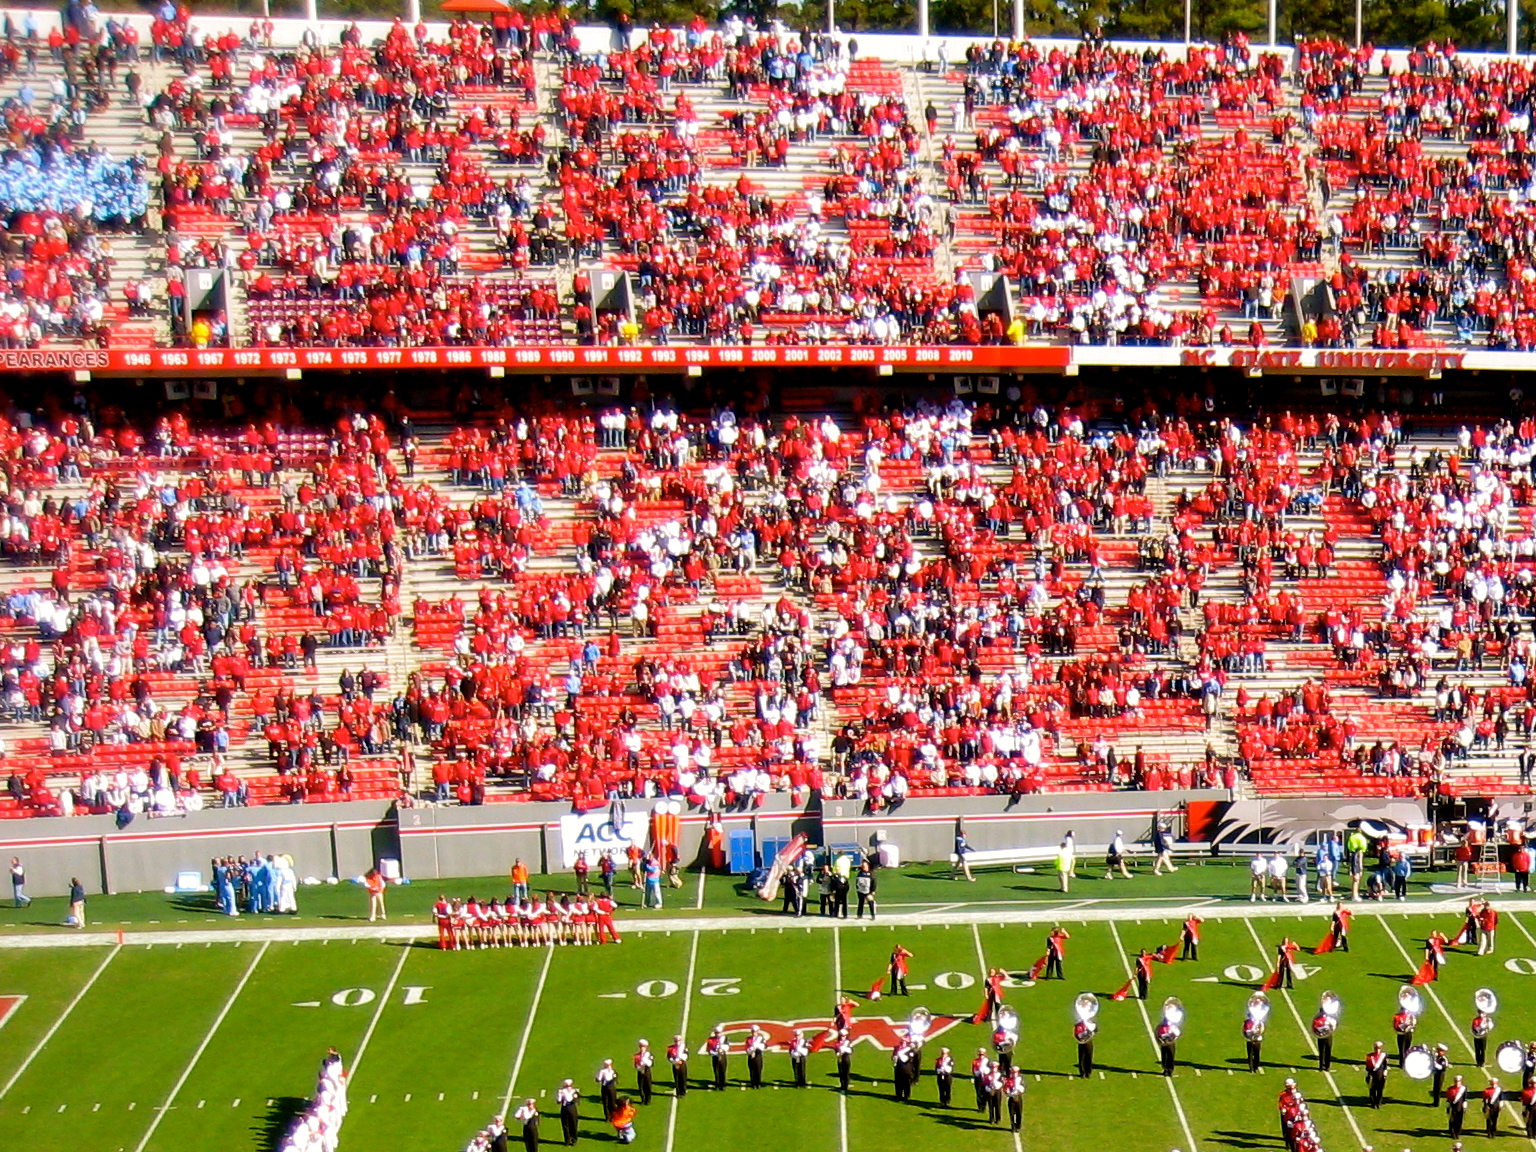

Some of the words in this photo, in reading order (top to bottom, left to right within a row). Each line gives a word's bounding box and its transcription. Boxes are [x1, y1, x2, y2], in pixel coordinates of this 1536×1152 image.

[123, 352, 152, 365] 1946
[233, 352, 261, 365] 1972
[269, 352, 297, 365] 1973
[305, 352, 333, 365] 1974
[340, 352, 368, 365] 1975
[376, 351, 403, 364] 1977
[411, 351, 438, 364] 1978
[515, 351, 541, 364] 1989
[549, 350, 575, 362] 1990
[583, 350, 608, 362] 1991
[617, 350, 643, 362] 1992
[651, 350, 677, 362] 1993
[684, 350, 710, 362] 1994
[718, 350, 744, 362] 1998
[751, 350, 777, 362] 2000
[784, 350, 809, 362] 2001
[817, 350, 843, 362] 2002
[850, 350, 875, 362] 2003
[882, 350, 908, 362] 2005
[915, 350, 940, 362] 2008
[948, 350, 974, 362] 2010
[1180, 349, 1217, 366] NC
[1228, 350, 1302, 367] STATE
[1315, 351, 1468, 369] UNIVERSITY
[574, 821, 633, 844] ACC
[573, 846, 629, 858] NETWOR
